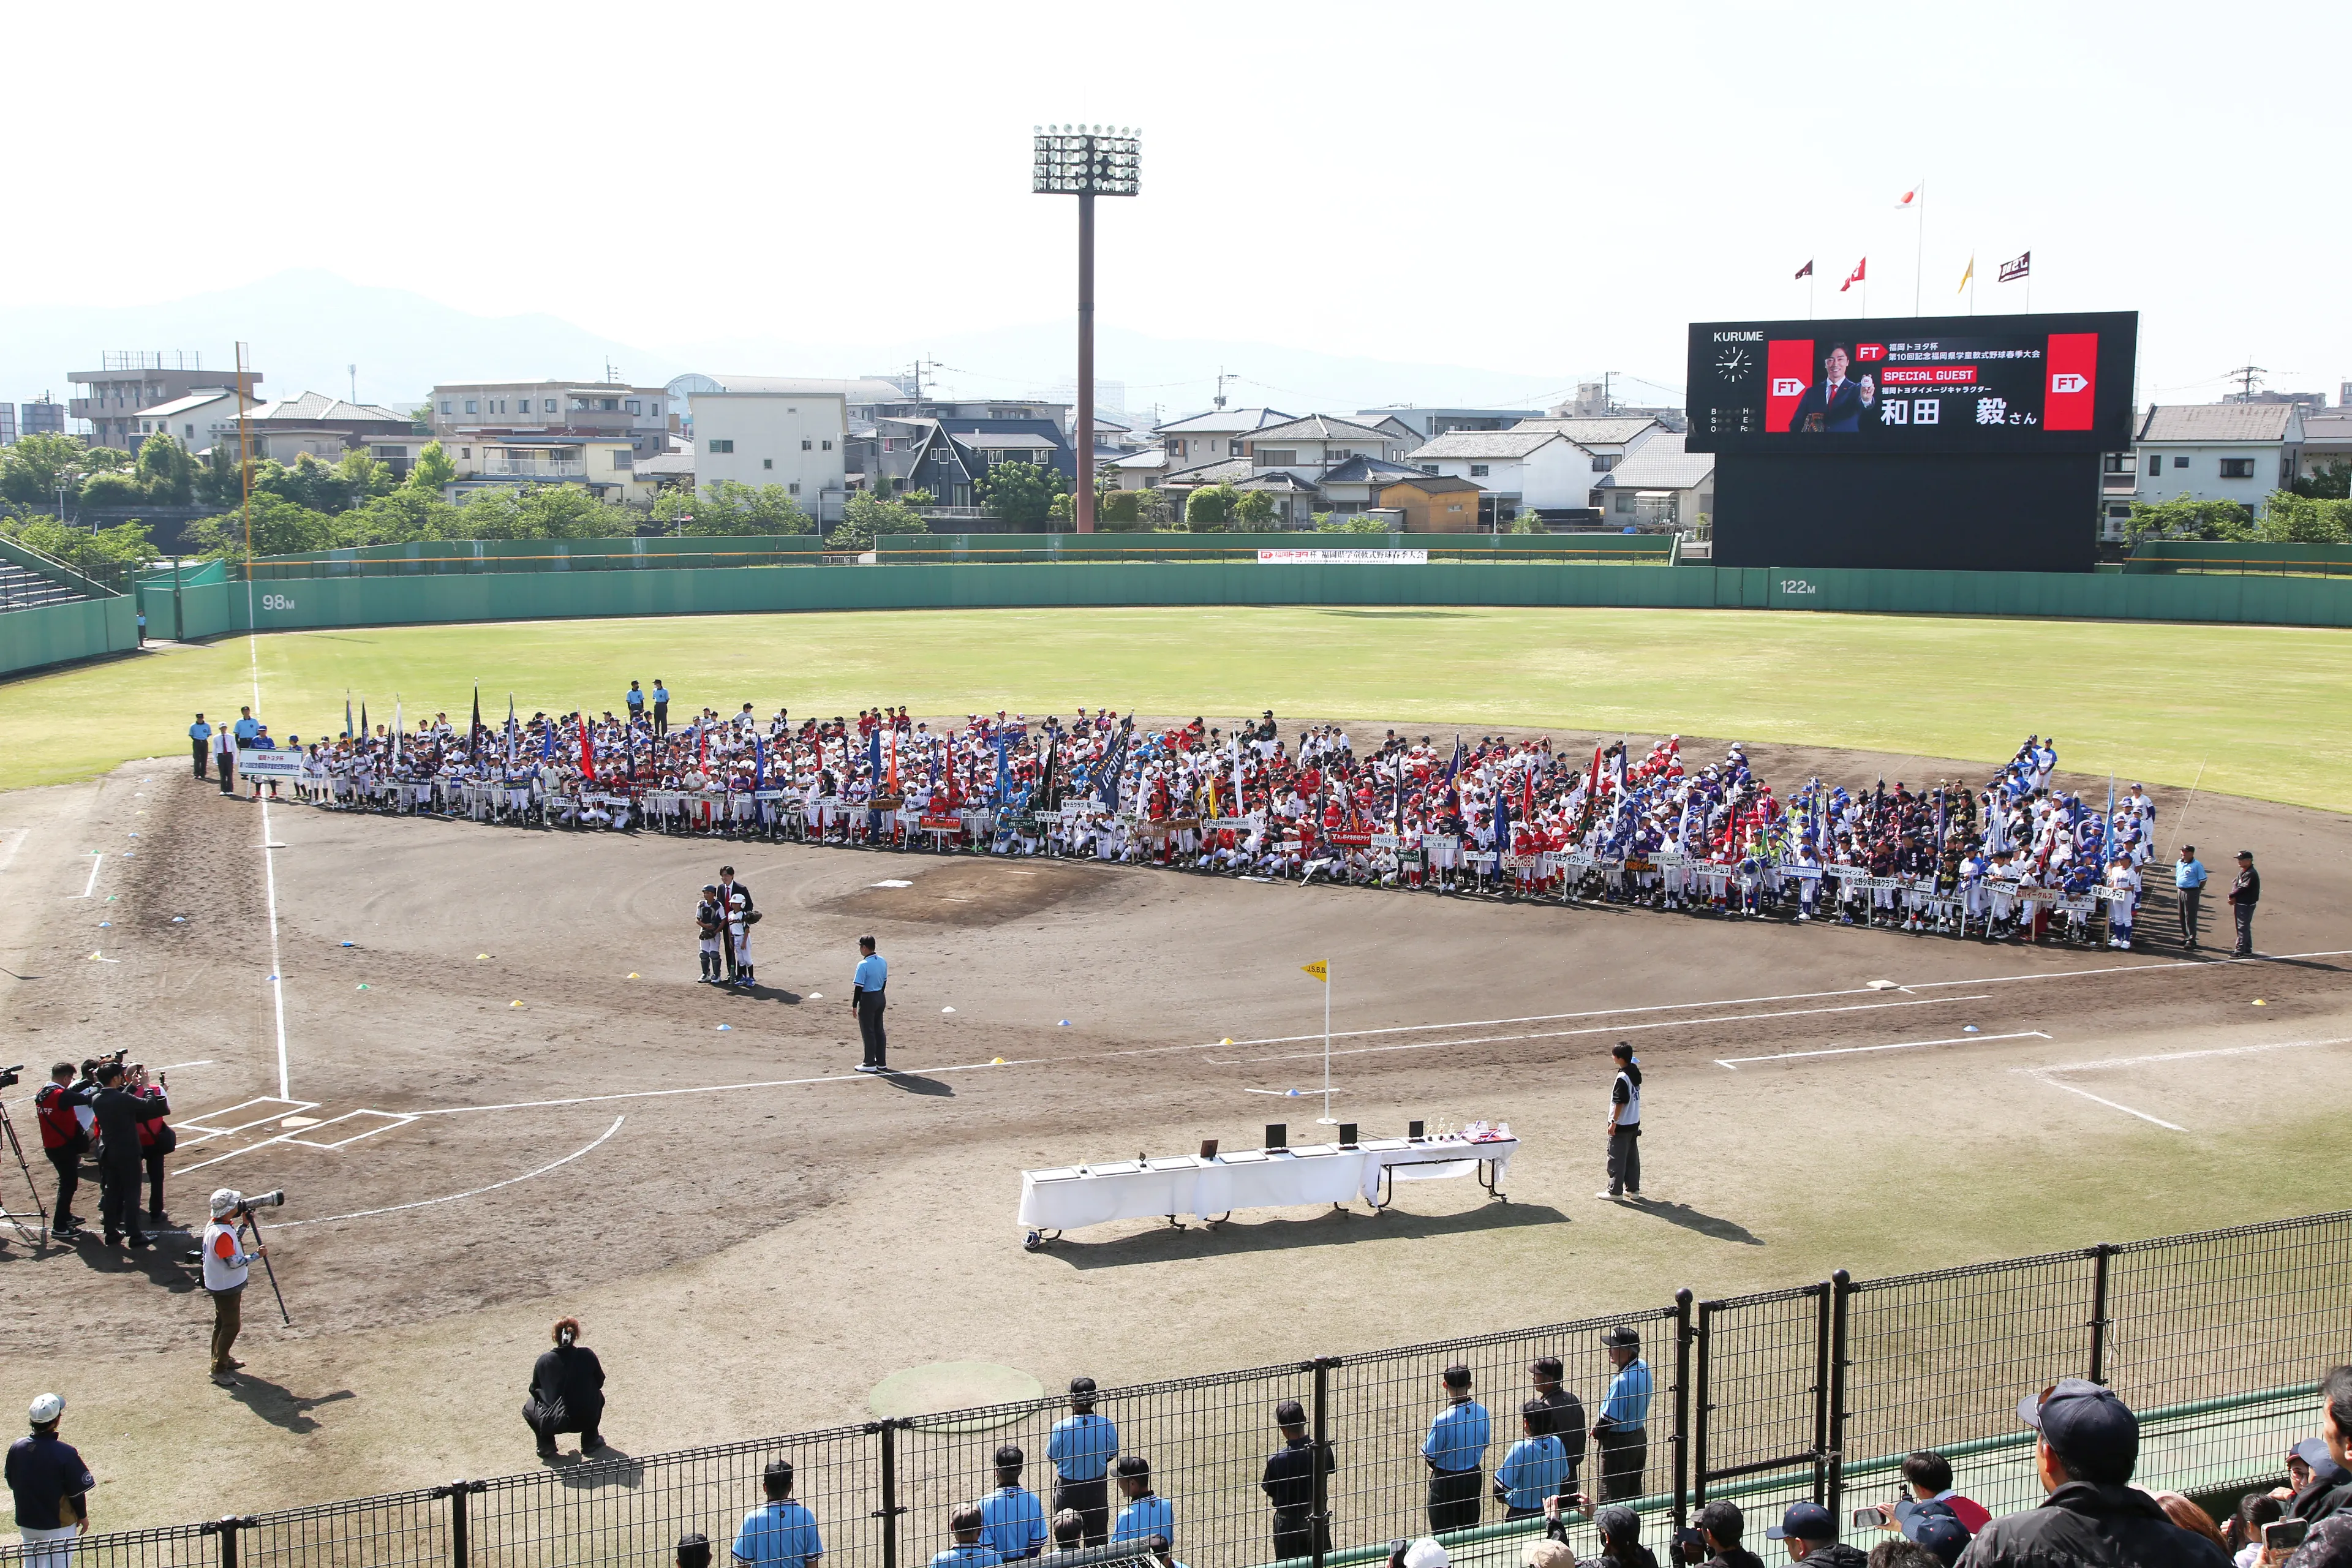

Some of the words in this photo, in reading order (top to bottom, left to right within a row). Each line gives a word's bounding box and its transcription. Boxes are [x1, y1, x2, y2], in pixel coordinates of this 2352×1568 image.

[1714, 331, 1763, 342] KURUME
[1889, 342, 1939, 351] 福岡トヨタ杯
[1860, 347, 1879, 358] FT
[1888, 350, 2040, 361] 第10回記念福岡県学童軟式野球春季大会
[1884, 371, 1932, 382] SPECIAL
[1936, 370, 1973, 380] GUEST
[1778, 382, 1796, 393] FT
[2057, 378, 2079, 389] FT
[1882, 386, 1992, 395] 福岡トヨタイメージキャラクター
[1881, 399, 1940, 426] 和田
[1976, 398, 2007, 425] 毅
[2009, 412, 2037, 425] さん
[1781, 581, 1815, 594] 122M
[263, 595, 295, 609] 98M
[1504, 856, 1534, 867] フェニックスBBC
[1853, 877, 1894, 888] 北野少年野球クラブ
[1982, 878, 2016, 892] 福岡ライナーズ
[1920, 894, 1962, 904] 若久団地少年野球部
[2017, 891, 2053, 899] 広川イーグルス
[37, 1106, 53, 1115] TAFF
